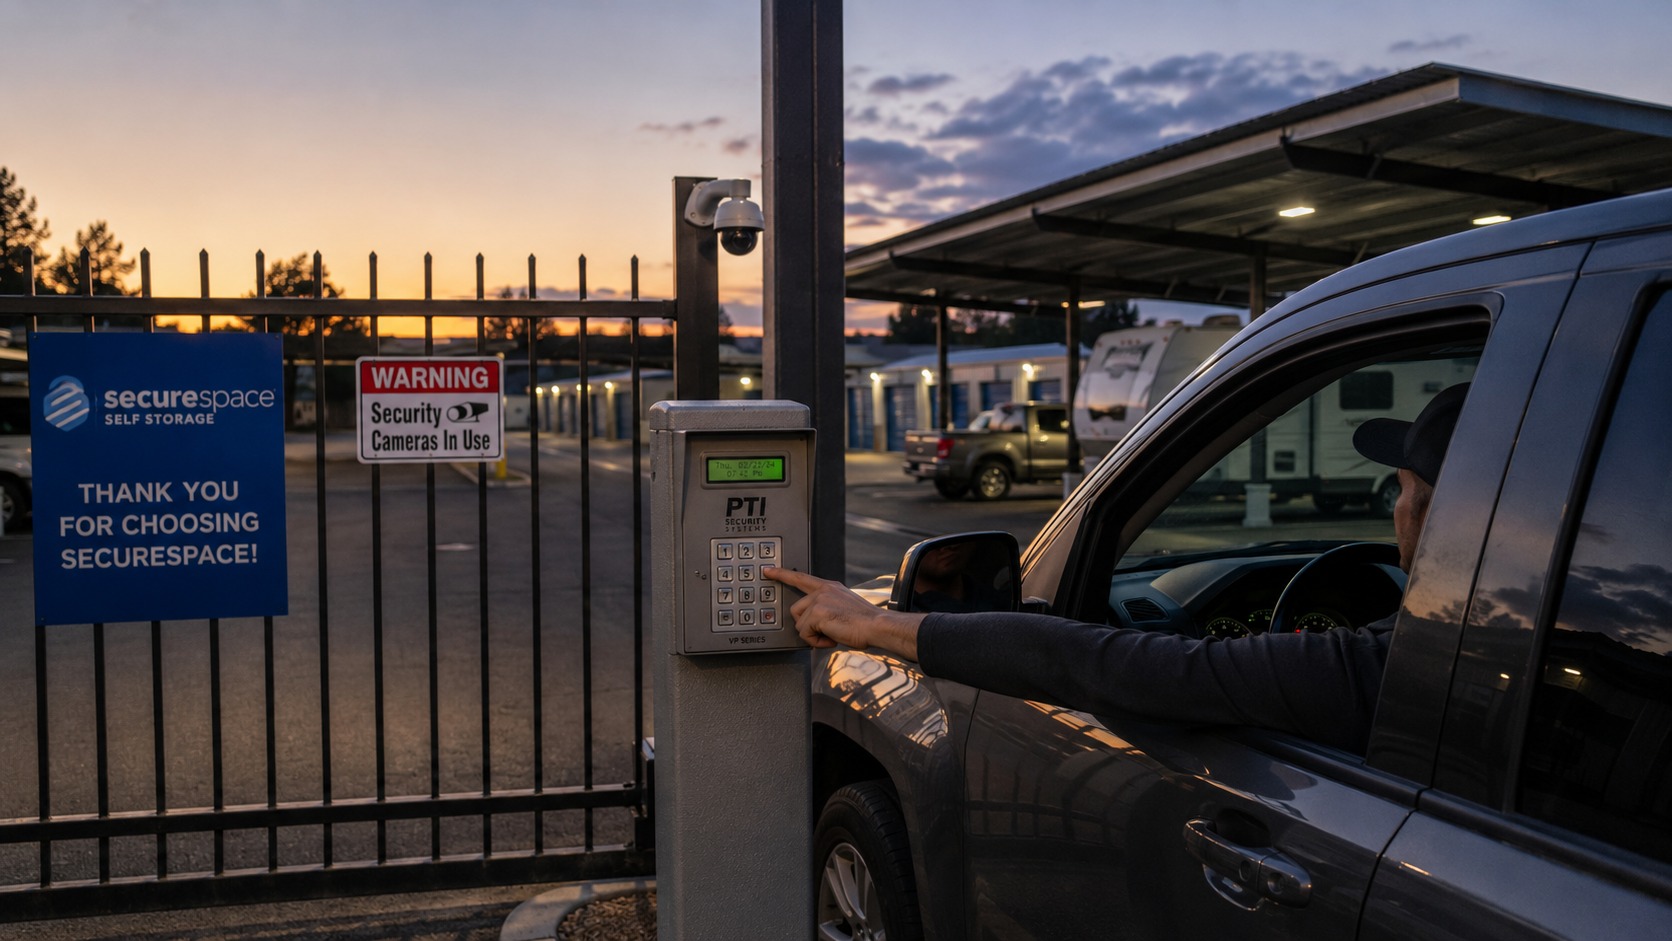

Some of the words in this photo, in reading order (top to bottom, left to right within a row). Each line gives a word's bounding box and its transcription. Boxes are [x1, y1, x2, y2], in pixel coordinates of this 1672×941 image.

[371, 366, 489, 389] WARNING
[104, 389, 275, 413] securespace
[104, 413, 140, 426] SELF
[145, 413, 215, 425] STORAGE
[371, 402, 442, 428] Security
[371, 430, 438, 451] Cameras
[444, 429, 458, 451] In
[463, 429, 490, 451] Use
[78, 482, 173, 504] THANK
[183, 481, 239, 501] YOU
[726, 497, 766, 517] PTI
[60, 516, 114, 537] FOR
[122, 512, 260, 535] CHOOSING
[725, 518, 766, 526] SECURITY
[61, 544, 258, 570] SECURESPACE!
[723, 548, 728, 557] 1
[743, 547, 750, 556] 2
[765, 546, 771, 555] 3
[722, 570, 729, 579] 4
[743, 569, 750, 578] 5
[723, 592, 729, 600] 7
[744, 590, 750, 600] 8
[744, 613, 750, 622] 0
[741, 636, 766, 644] SERIES
